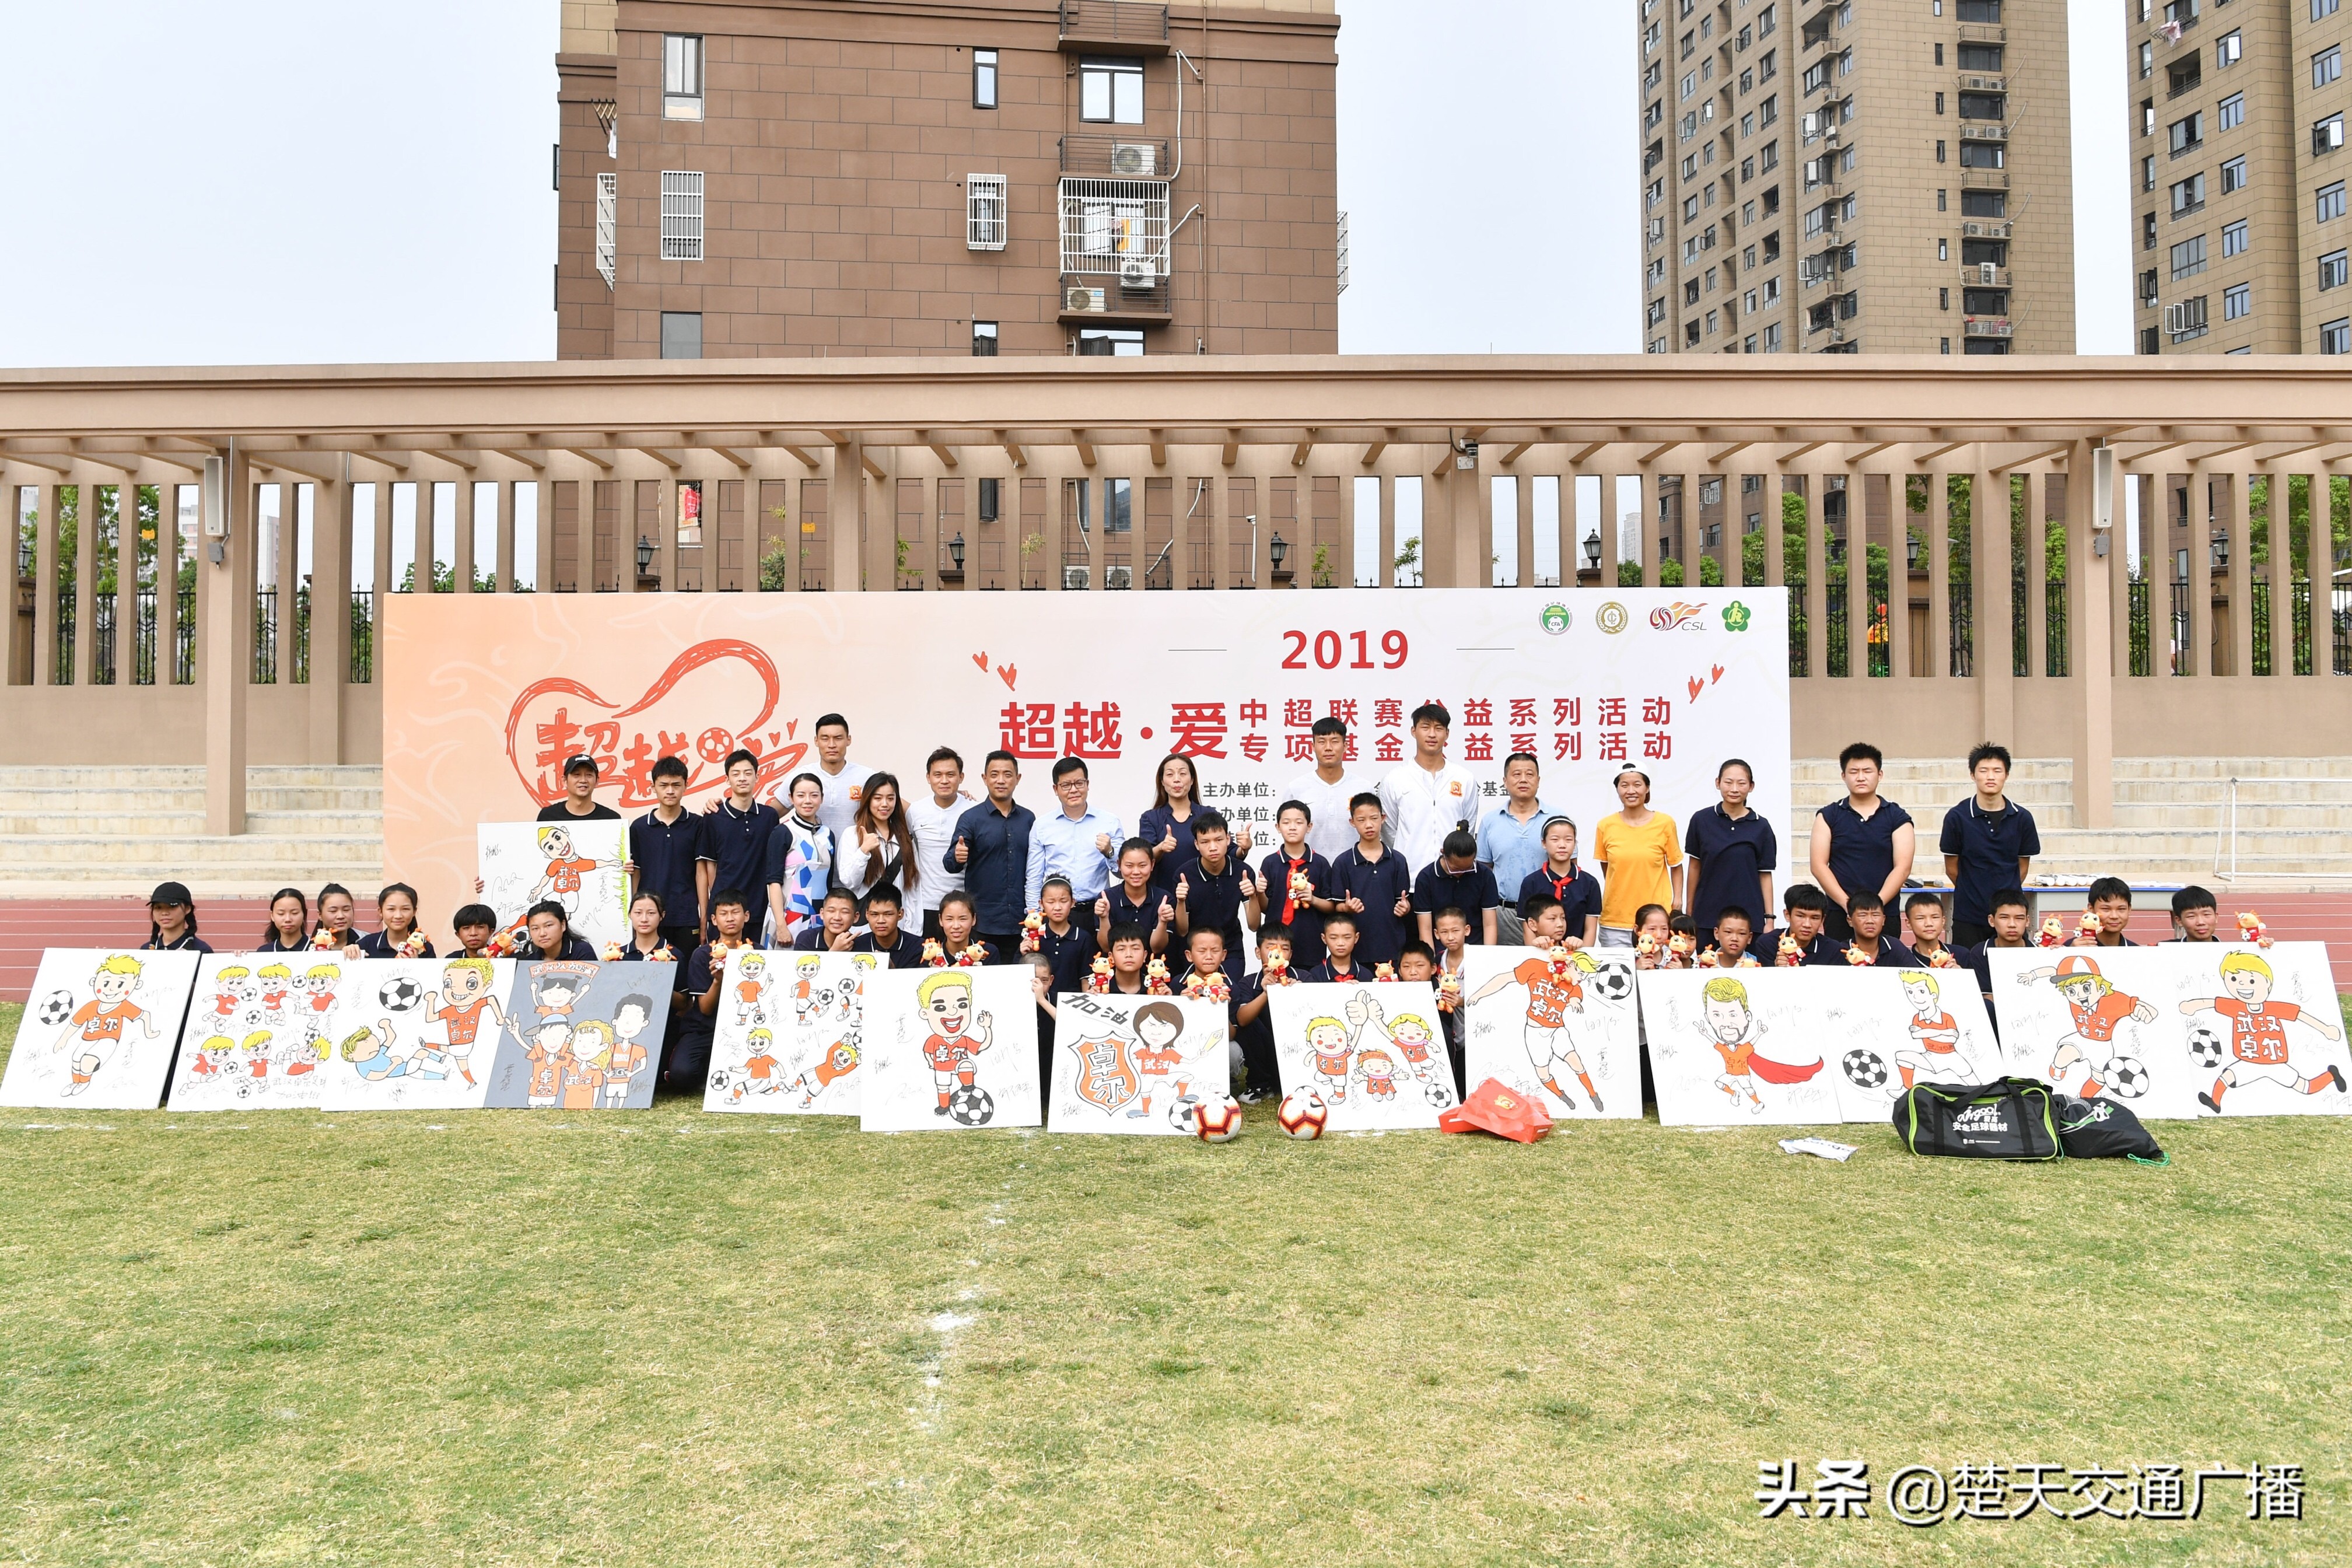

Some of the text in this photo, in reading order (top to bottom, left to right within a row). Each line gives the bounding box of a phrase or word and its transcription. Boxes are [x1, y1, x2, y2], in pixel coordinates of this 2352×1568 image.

[1681, 622, 1707, 631] CSL
[1281, 629, 1409, 669] 2019
[1240, 696, 1671, 728] 中超联赛益系列活动
[1240, 730, 1672, 762] 专项基金益系列活动
[1213, 806, 1276, 822] 办单位：
[558, 866, 578, 876] 武汉
[557, 878, 579, 890] 卓尔
[1532, 977, 1569, 1003] 武汉
[1061, 994, 1129, 1025] 加油
[1531, 999, 1563, 1024] 卓尔
[86, 1016, 119, 1034] 卓尔
[450, 1016, 475, 1027] 武汉
[2077, 1013, 2108, 1027] 武汉
[2236, 1011, 2281, 1033] 武汉
[2079, 1026, 2106, 1038] 卓尔
[2239, 1034, 2283, 1061] 卓尔
[1143, 1059, 1170, 1070] 武汉
[1726, 1057, 1747, 1069] 卓尔
[536, 1068, 553, 1095] 卓尔
[565, 1073, 593, 1086] 武汉
[1088, 1044, 1131, 1104] 卓尔
[1952, 1121, 2008, 1132] 安全足球器材
